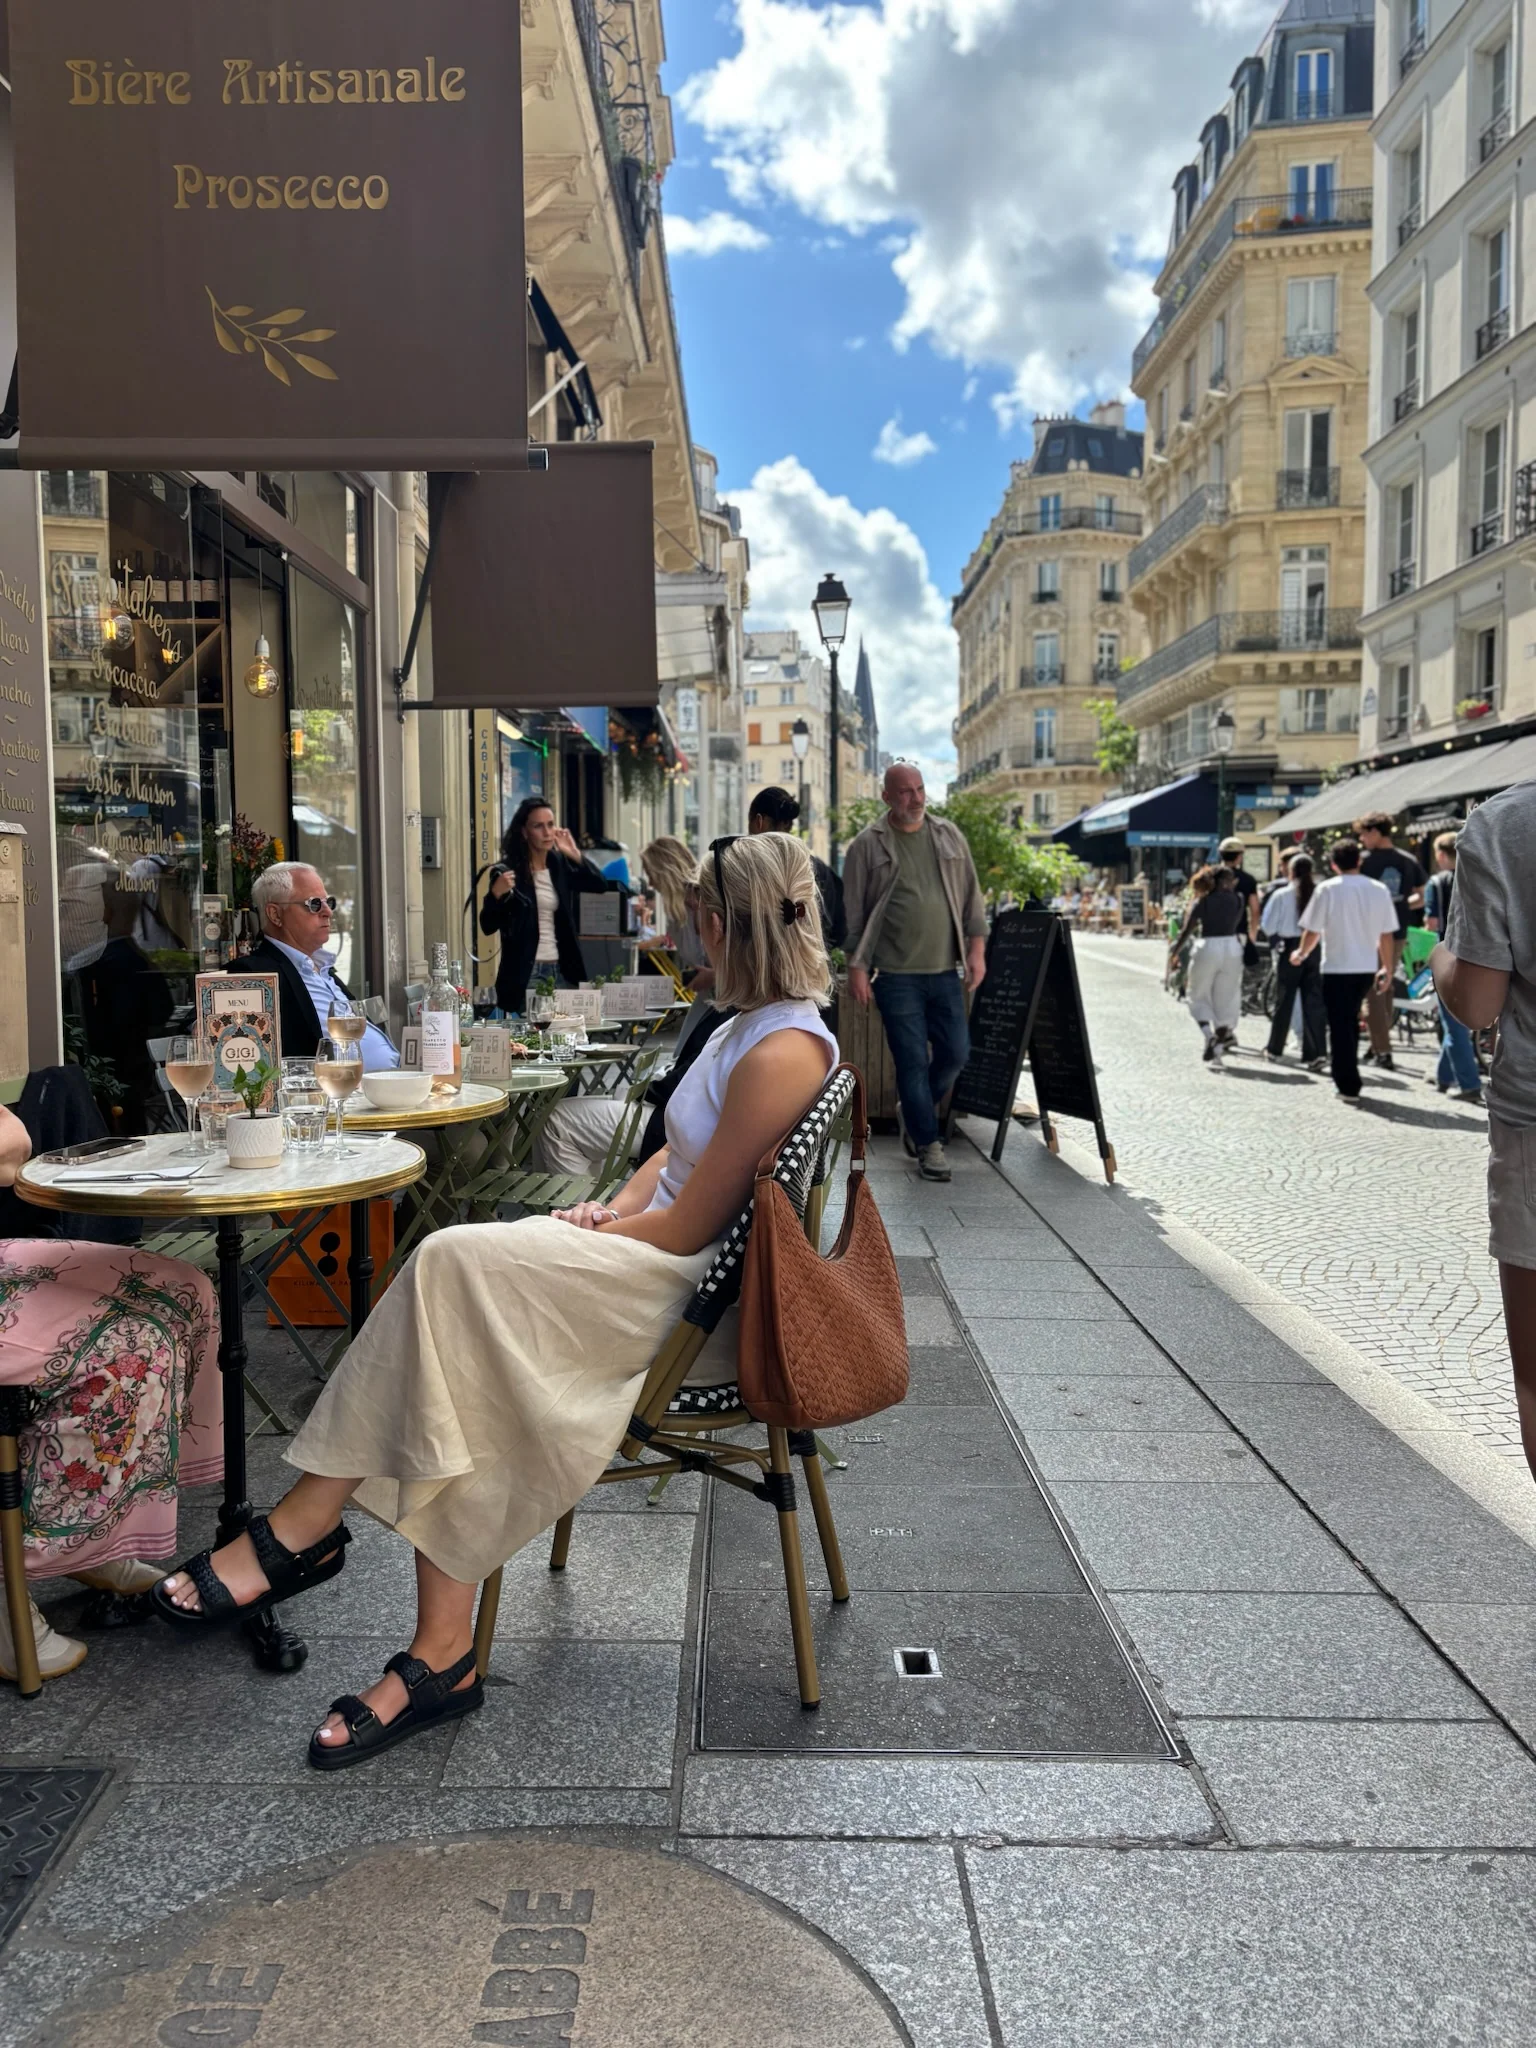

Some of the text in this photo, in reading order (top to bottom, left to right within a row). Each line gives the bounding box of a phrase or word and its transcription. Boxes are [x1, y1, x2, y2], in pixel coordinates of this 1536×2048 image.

[65, 57, 467, 105] Bière Artisanale
[173, 164, 390, 210] Prosecco
[91, 641, 160, 699] Focaccia
[85, 757, 122, 796] Pesto
[126, 763, 177, 807] Maison
[228, 999, 249, 1007] MENU
[225, 1046, 256, 1060] GIGI
[293, 1279, 336, 1287] KILIWAH
[872, 1527, 909, 1537] PTT
[473, 1889, 595, 2048] ABBÉ
